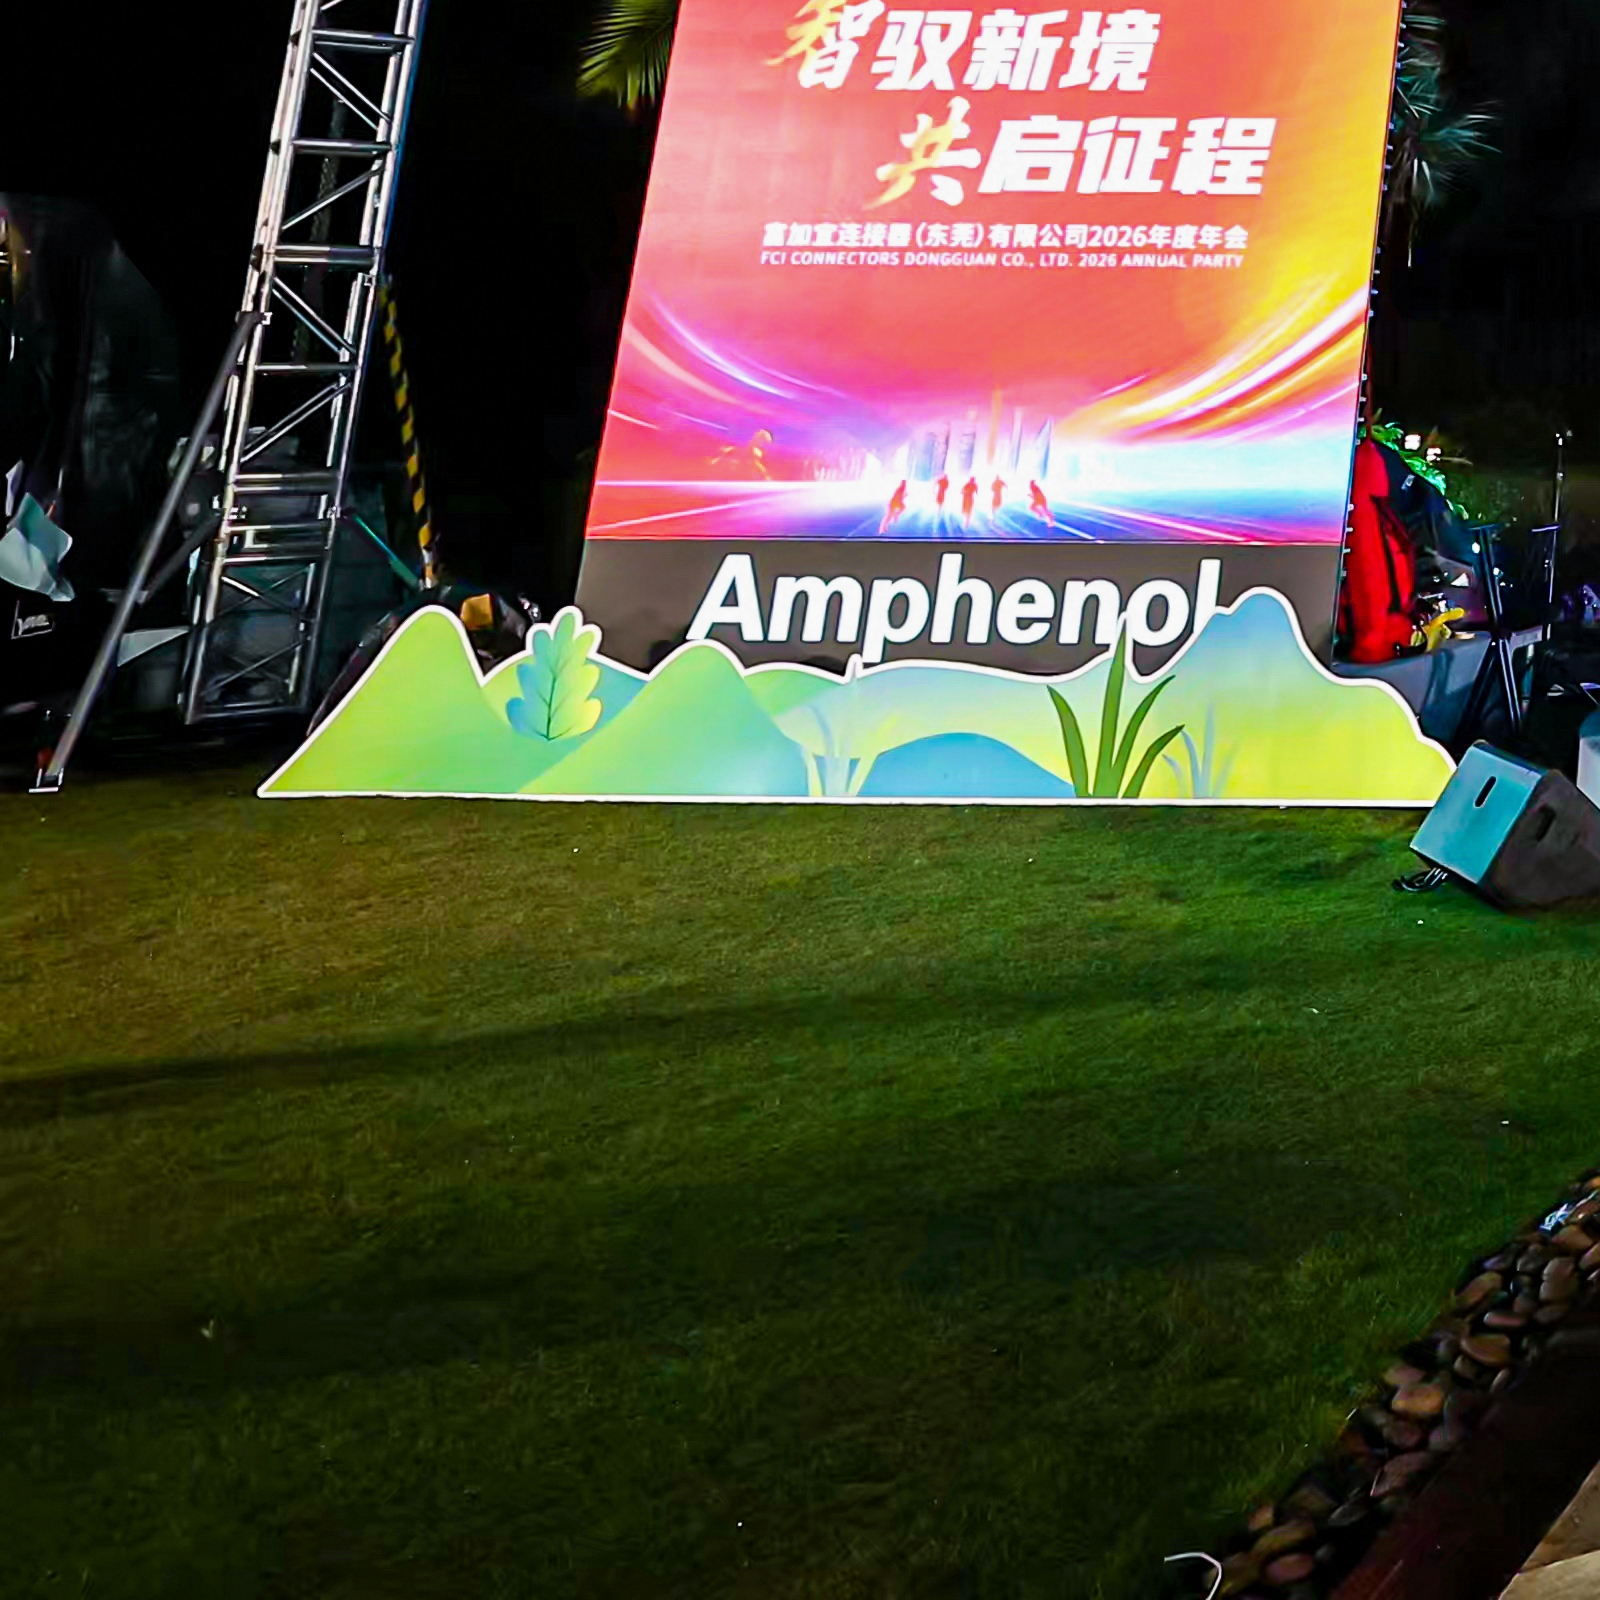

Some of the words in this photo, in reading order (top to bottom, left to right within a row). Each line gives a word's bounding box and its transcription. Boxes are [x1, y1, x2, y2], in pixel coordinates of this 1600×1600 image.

[864, 95, 1277, 207] 共启征程
[760, 251, 786, 265] FCI
[790, 251, 899, 266] CONNECTORS
[903, 252, 998, 267] DONGGUAN
[1001, 252, 1035, 268] CO.,
[1039, 253, 1073, 268] LTD.
[1078, 253, 1117, 268] 2026
[1121, 253, 1187, 268] ANNUAL
[1192, 253, 1244, 268] PARTY
[686, 553, 1221, 662] Amphenol
